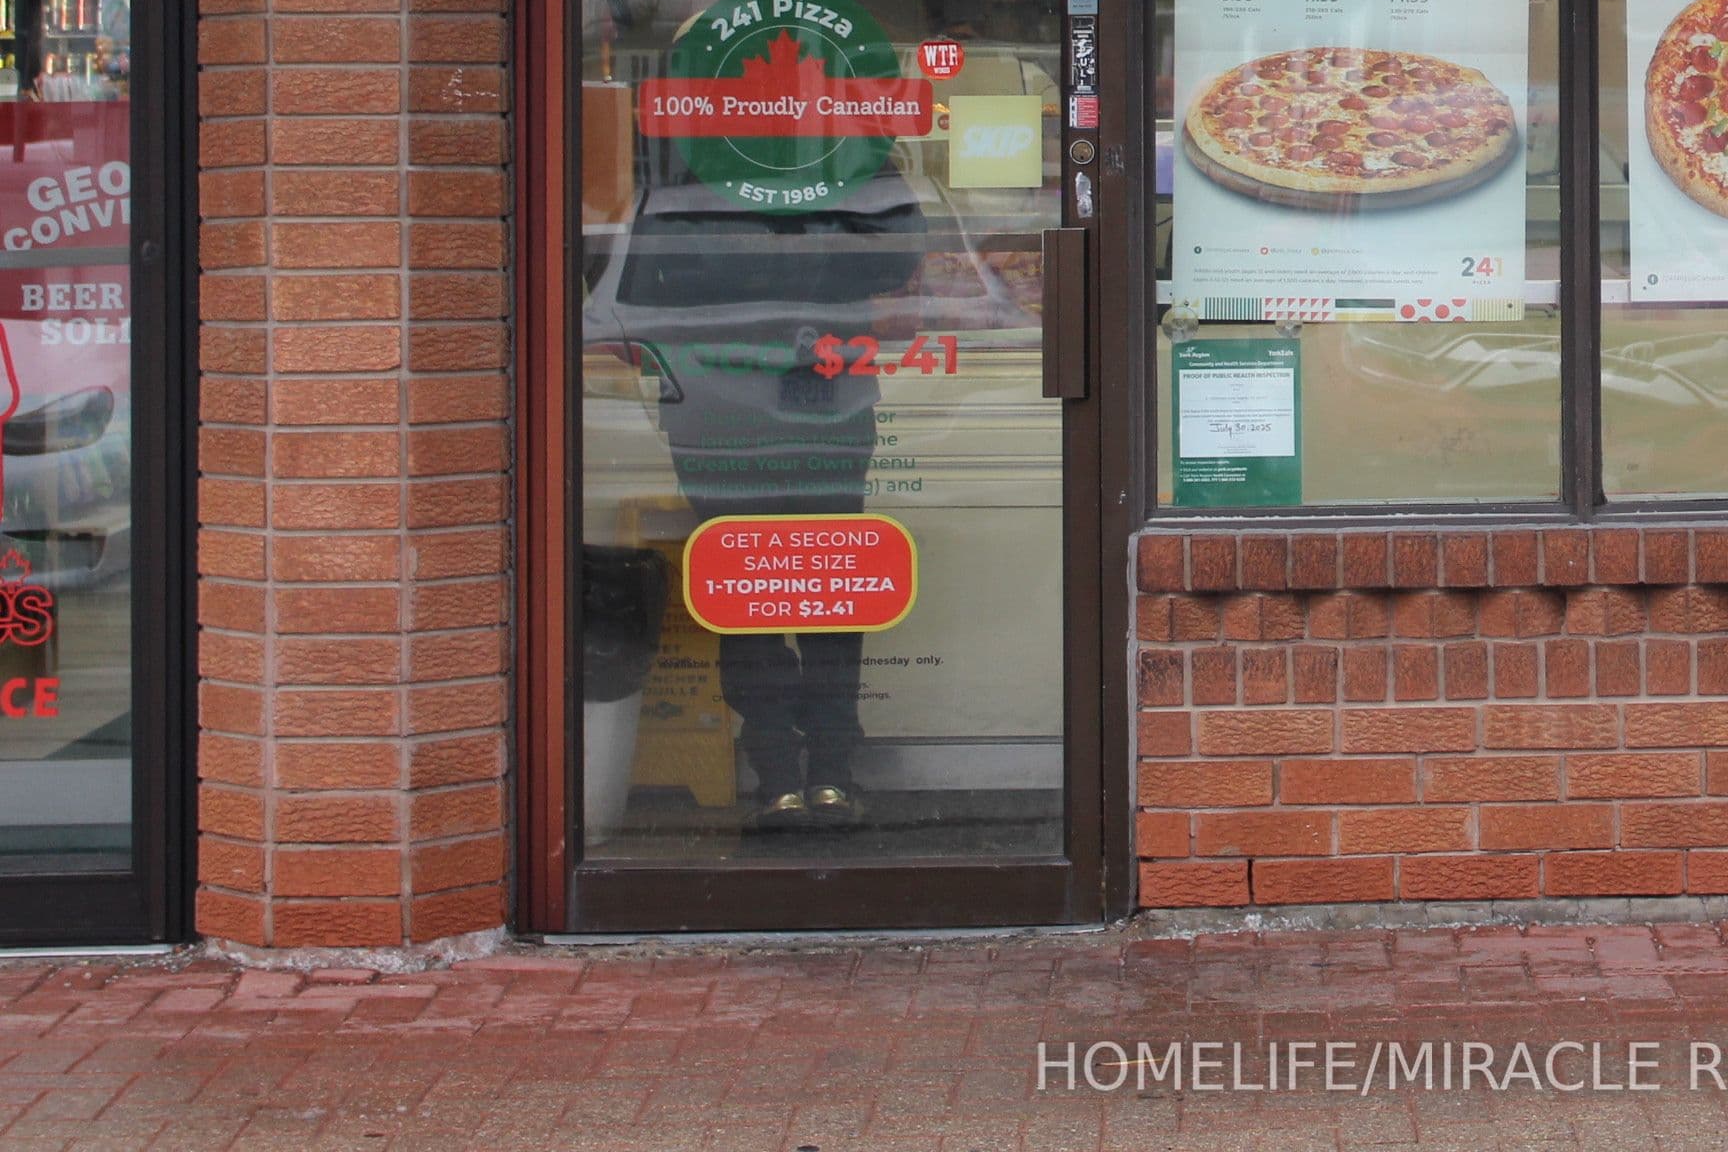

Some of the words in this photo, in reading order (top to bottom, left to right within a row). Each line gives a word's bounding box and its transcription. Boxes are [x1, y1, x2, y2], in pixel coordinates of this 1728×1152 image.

[711, 0, 763, 42] 241
[653, 96, 714, 116] 100%
[722, 96, 807, 120] Proudly
[816, 96, 920, 116] Canadian
[959, 125, 1035, 158] SKIP
[27, 161, 131, 212] GEO
[738, 181, 777, 204] EST
[782, 181, 828, 205] 1986
[1461, 256, 1503, 277] 241
[21, 283, 124, 311] BEER
[814, 334, 957, 379] $2.41
[886, 478, 922, 493] and
[721, 533, 762, 548] GET
[768, 532, 783, 548] A
[789, 531, 879, 547] SECOND
[744, 554, 804, 570] SAME
[811, 554, 856, 569] SIZE
[706, 578, 822, 595] 1-TOPPING
[830, 577, 895, 593] PIZZA
[748, 601, 792, 617] FOR
[799, 600, 854, 617] $2.41
